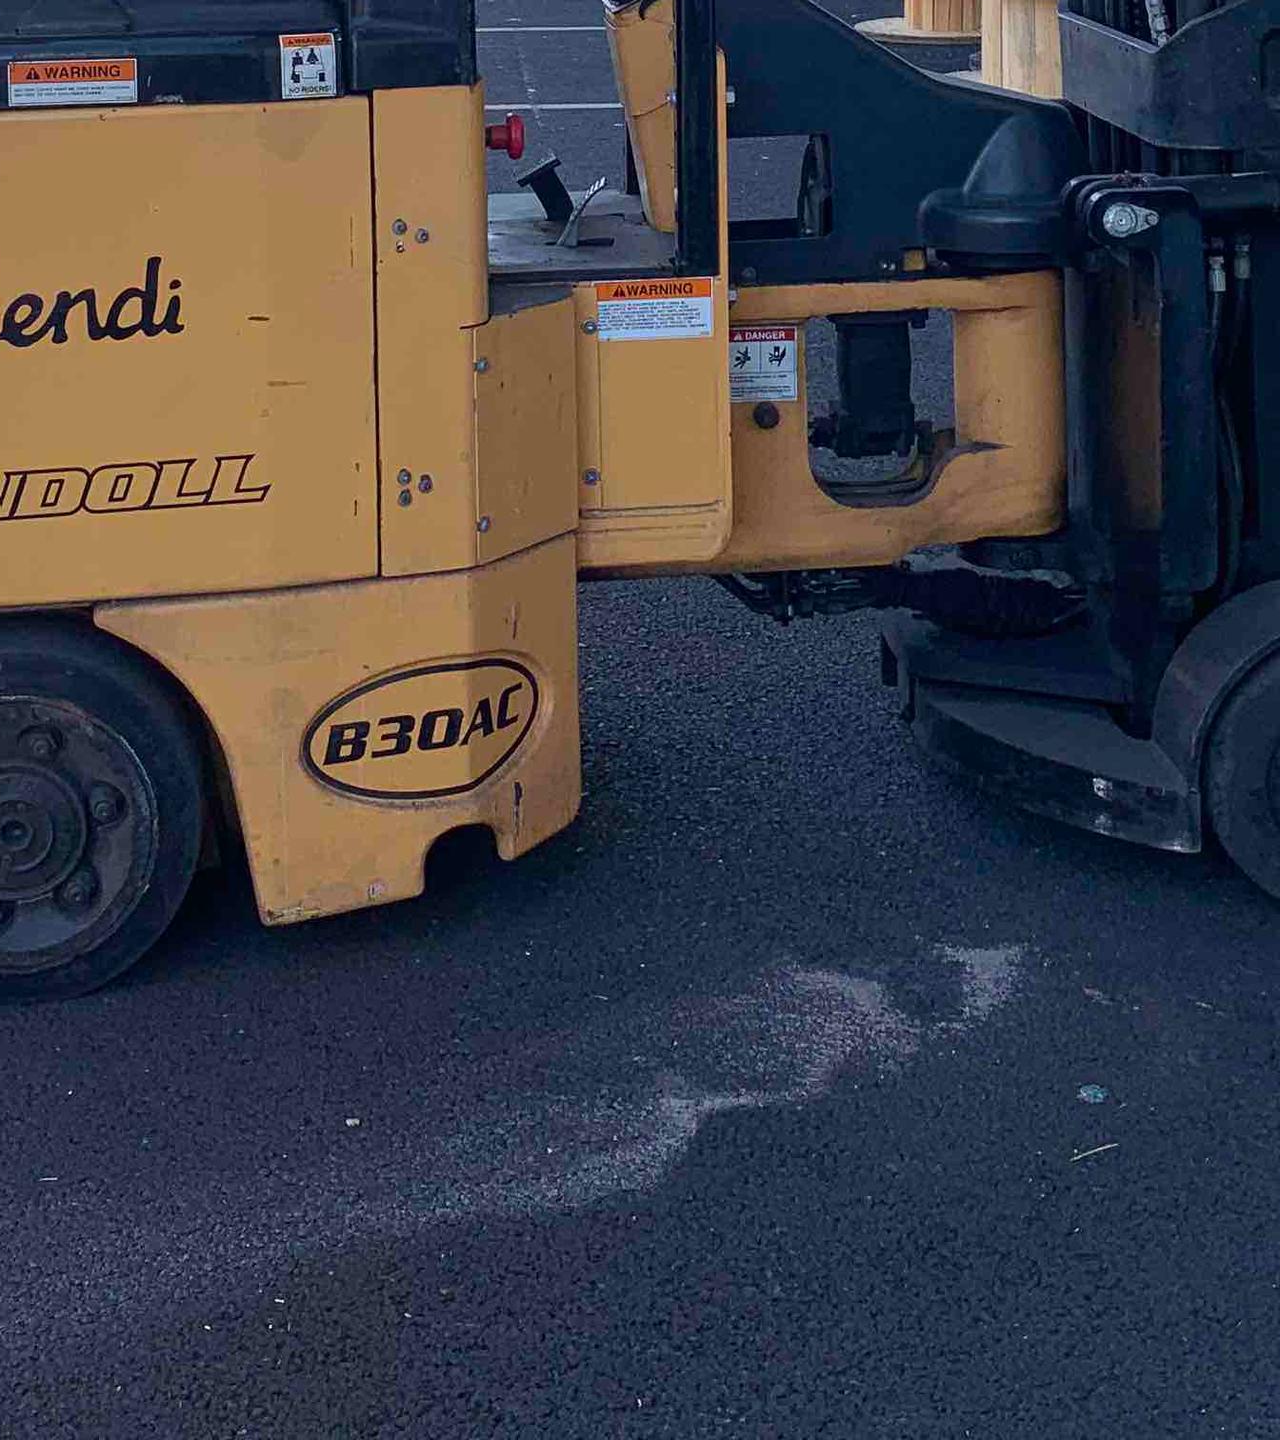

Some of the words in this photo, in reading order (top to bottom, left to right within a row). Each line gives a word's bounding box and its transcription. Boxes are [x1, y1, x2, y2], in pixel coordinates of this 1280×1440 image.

[44, 64, 120, 80] WARNING
[289, 86, 301, 94] NO
[626, 282, 693, 297] WARNING
[745, 330, 787, 340] DANGER
[322, 681, 523, 766] B30AC
